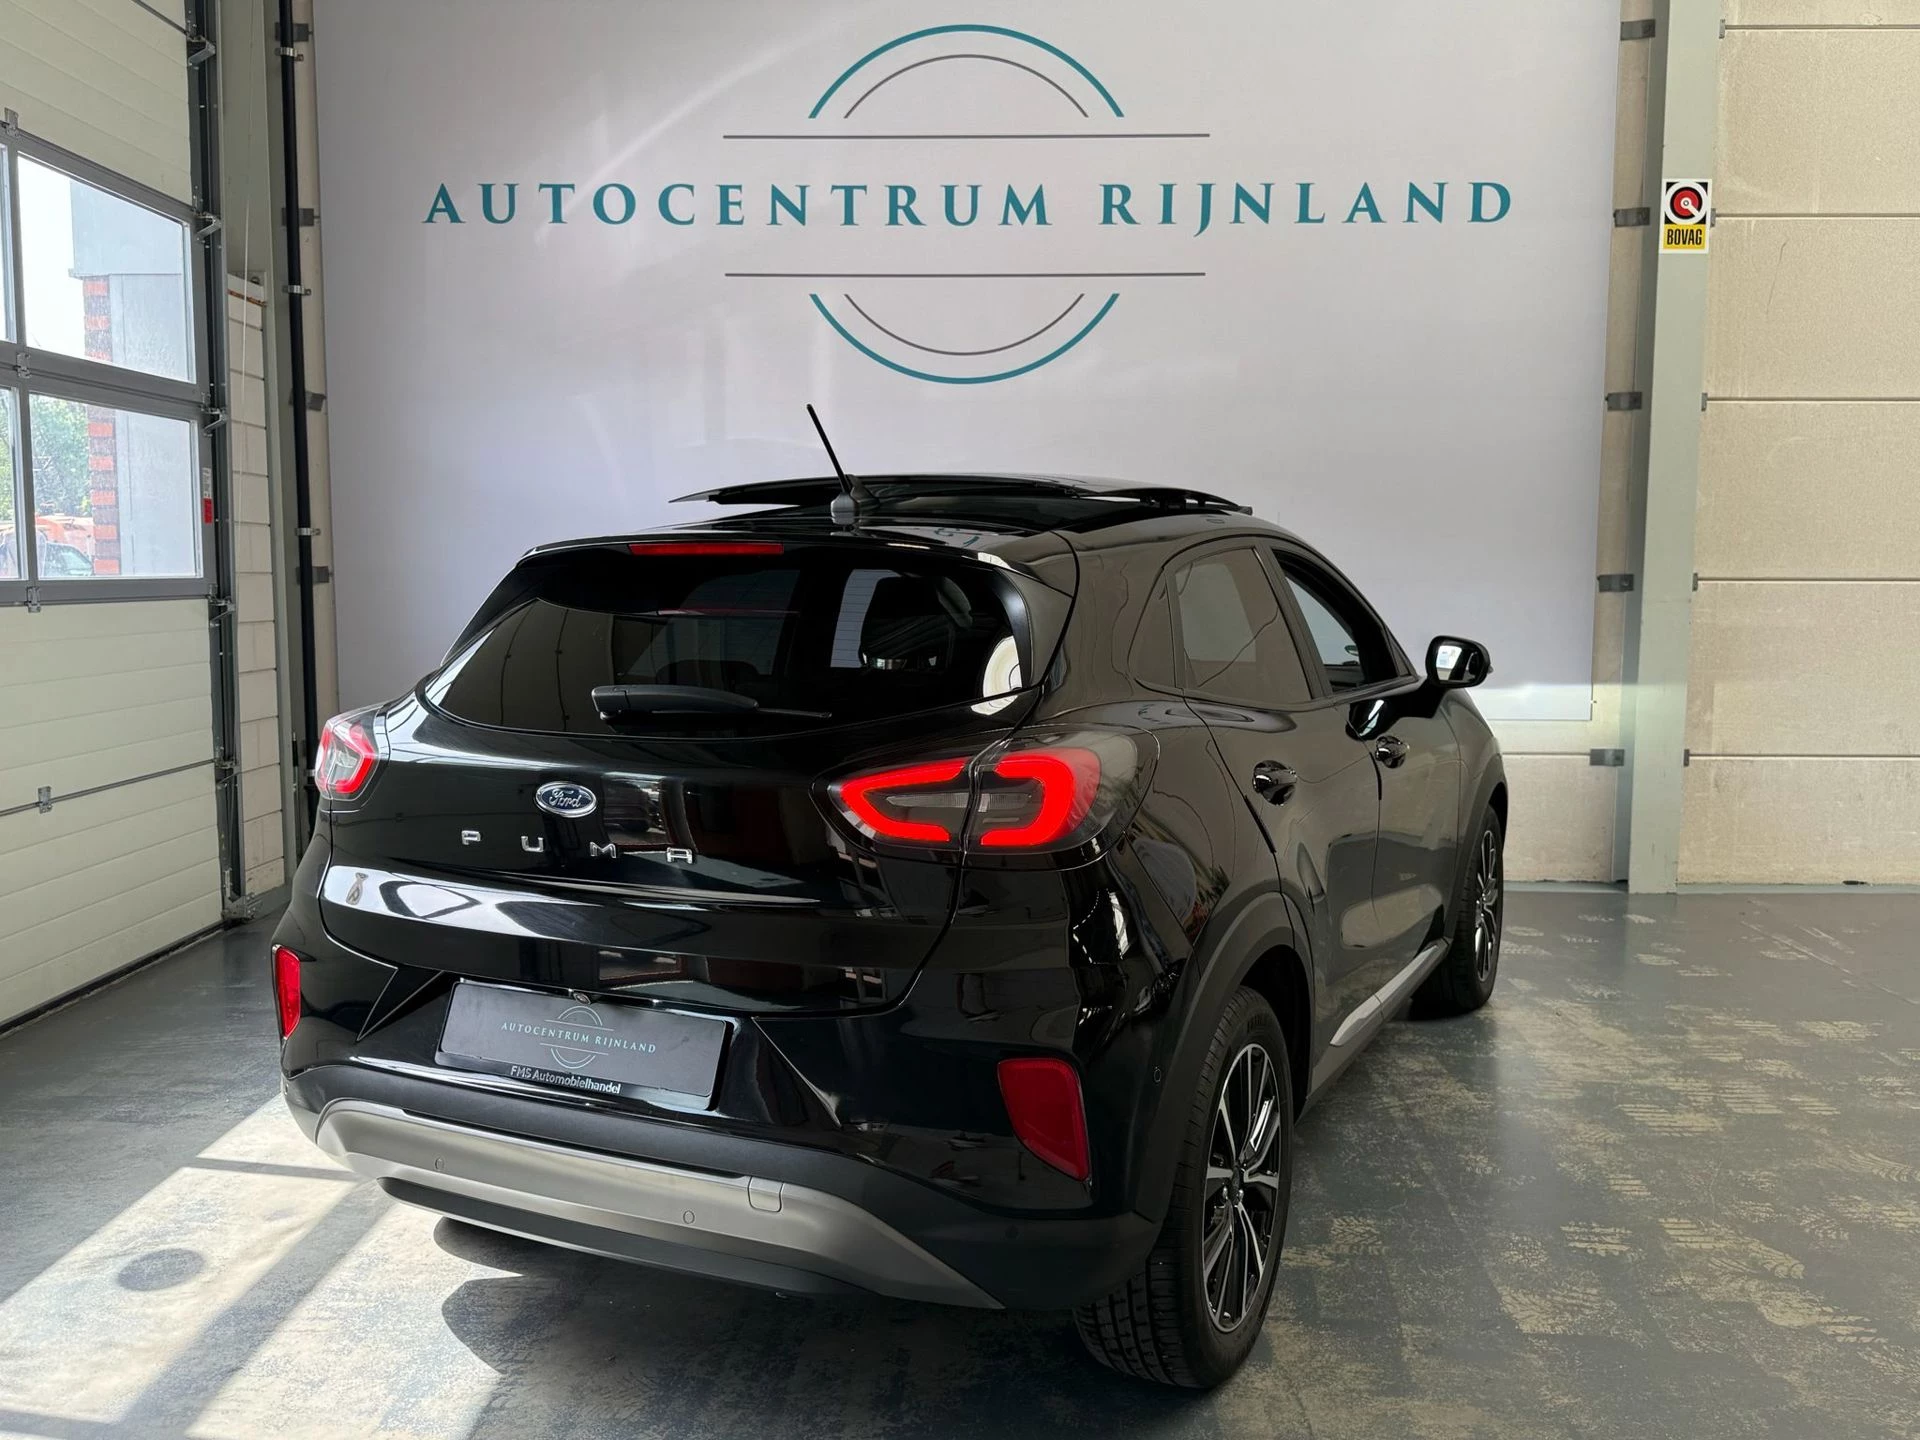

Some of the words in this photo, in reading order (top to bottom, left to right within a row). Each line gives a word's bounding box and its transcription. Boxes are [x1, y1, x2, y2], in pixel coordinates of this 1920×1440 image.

[422, 183, 1052, 227] AUTOCENTRUM
[1098, 181, 1511, 237] RIJNLAND
[1666, 228, 1702, 245] BOVAG
[549, 787, 581, 809] Ford
[462, 830, 693, 864] PUMA
[501, 1022, 589, 1043] AUTOCENTRUM
[595, 1035, 656, 1053] RIJNLAND
[510, 1065, 532, 1079] FMS
[533, 1069, 621, 1094] Automobielhandel
